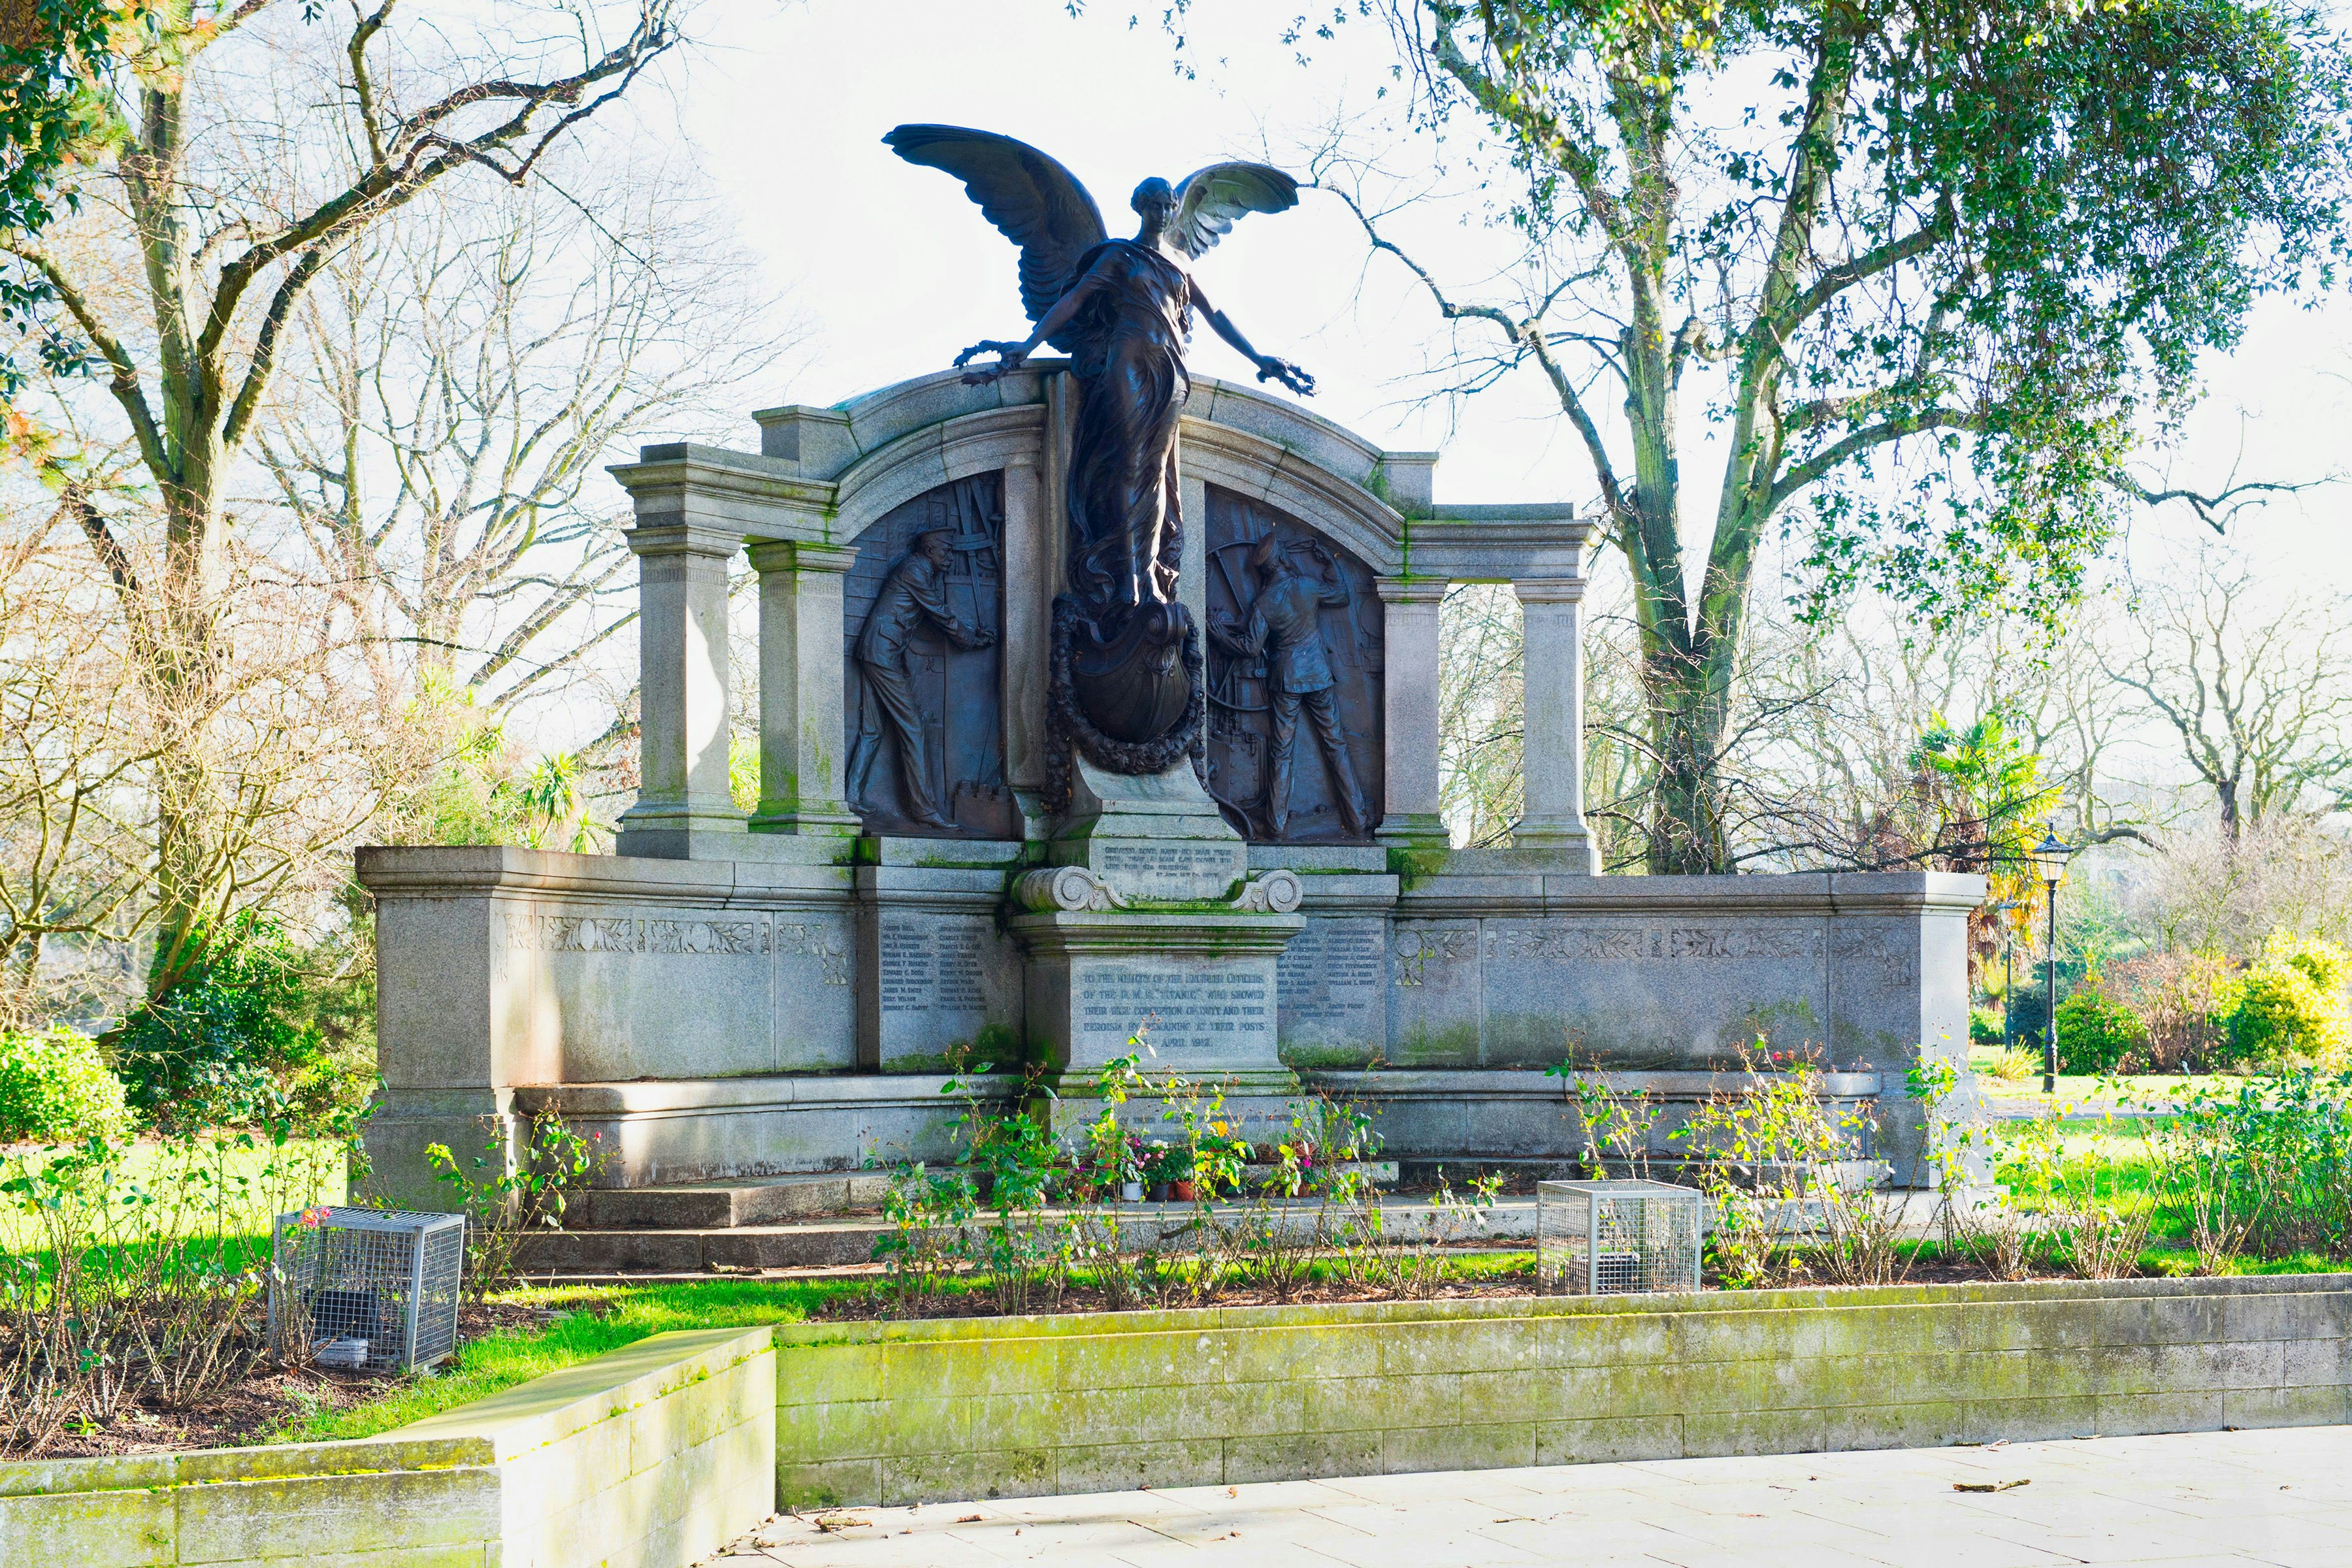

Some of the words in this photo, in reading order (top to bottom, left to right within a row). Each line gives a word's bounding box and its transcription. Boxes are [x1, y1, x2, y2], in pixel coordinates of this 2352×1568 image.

[1083, 973, 1095, 983] TO
[1098, 973, 1113, 983] THE
[1117, 973, 1151, 983] MEMORY
[1153, 973, 1164, 983] OF
[1168, 973, 1181, 983] THE
[1185, 973, 1224, 983] ENGINEER
[1227, 973, 1264, 983] OFFICERS
[1083, 990, 1095, 999] OF
[1099, 990, 1117, 999] THE
[1207, 990, 1226, 999] WHO
[1231, 990, 1264, 999] SHOWED
[1084, 1006, 1107, 1015] THEIR
[1111, 1006, 1132, 1015] HIGH
[1134, 1006, 1183, 1015] CONCEPTION
[1186, 1006, 1196, 1015] OF
[1200, 1006, 1220, 1015] DUTY
[1223, 1006, 1239, 1015] AND
[1242, 1006, 1264, 1015] THEIR
[1083, 1022, 1122, 1031] HEROISM
[1128, 1022, 1139, 1031] BY
[1196, 1022, 1207, 1031] AT
[1210, 1022, 1234, 1031] THEIR
[1239, 1022, 1264, 1031] POSTS
[1161, 1038, 1184, 1047] APRIL
